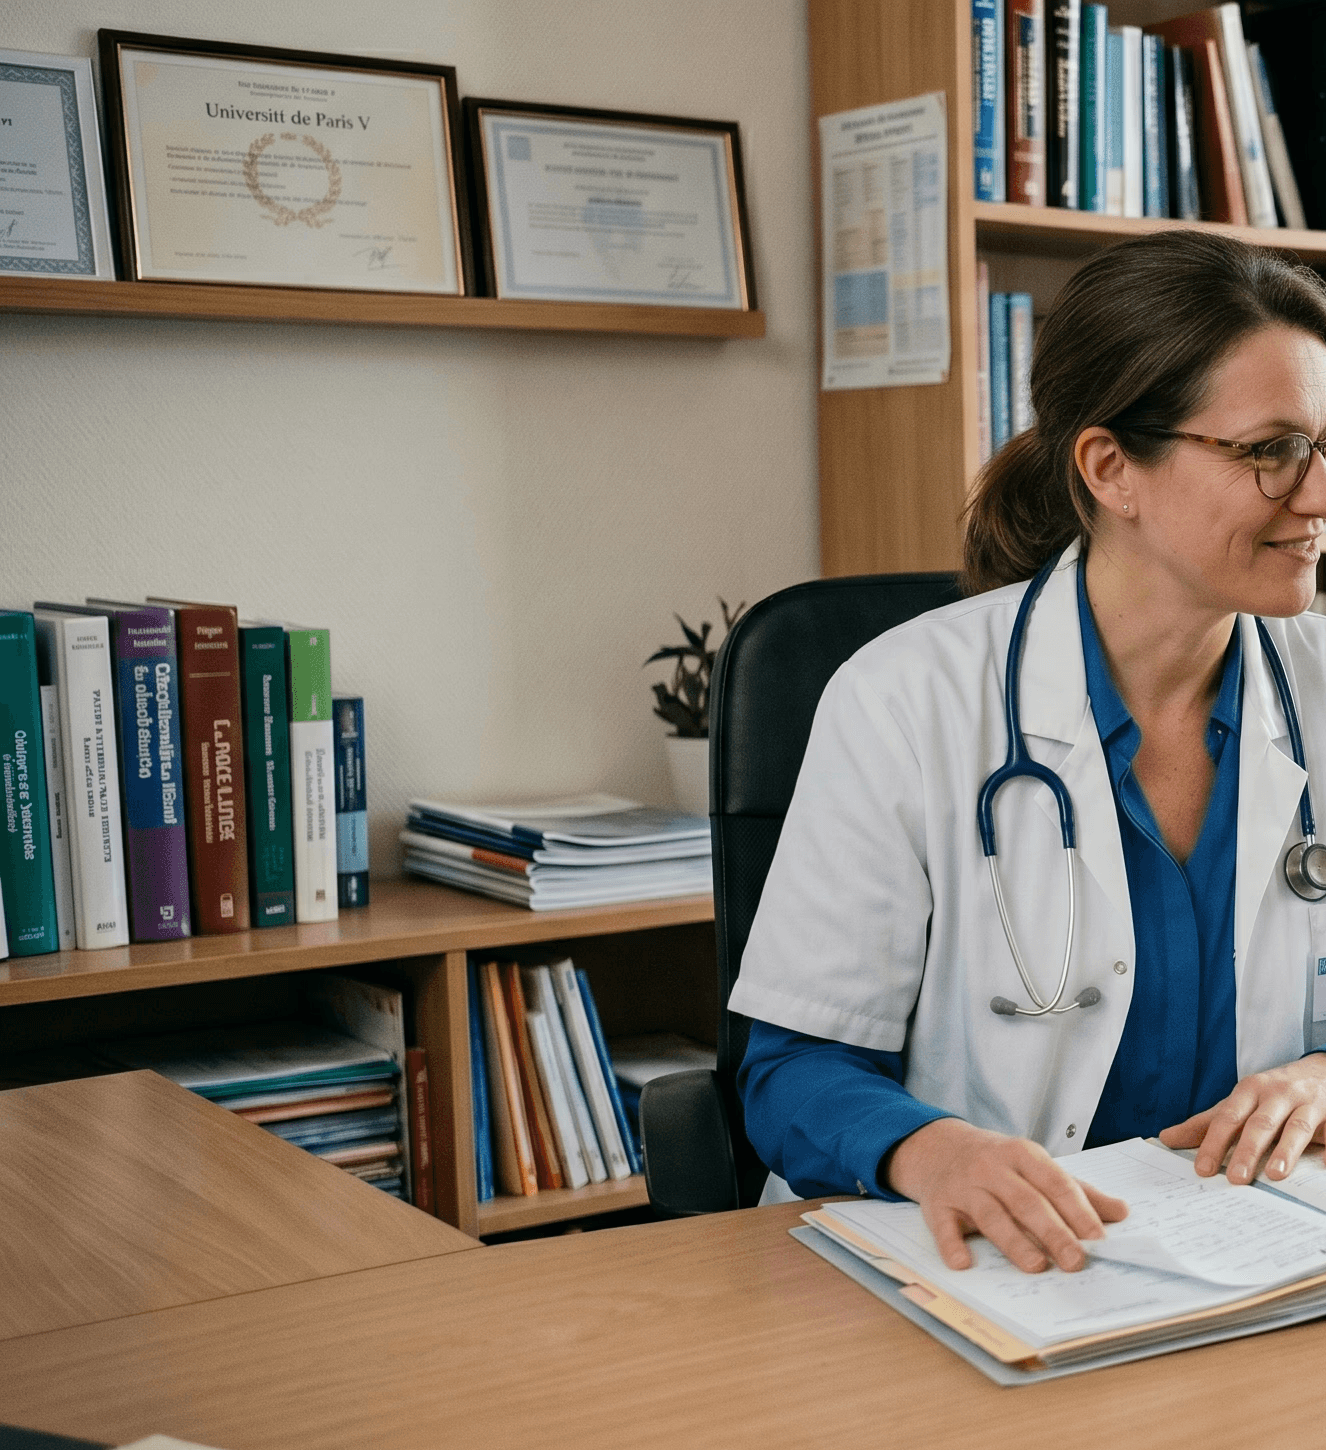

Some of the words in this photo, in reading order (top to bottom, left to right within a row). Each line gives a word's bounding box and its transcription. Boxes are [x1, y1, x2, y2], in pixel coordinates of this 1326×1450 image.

[291, 110, 311, 126] de
[316, 112, 354, 130] Paris
[357, 115, 371, 131] V
